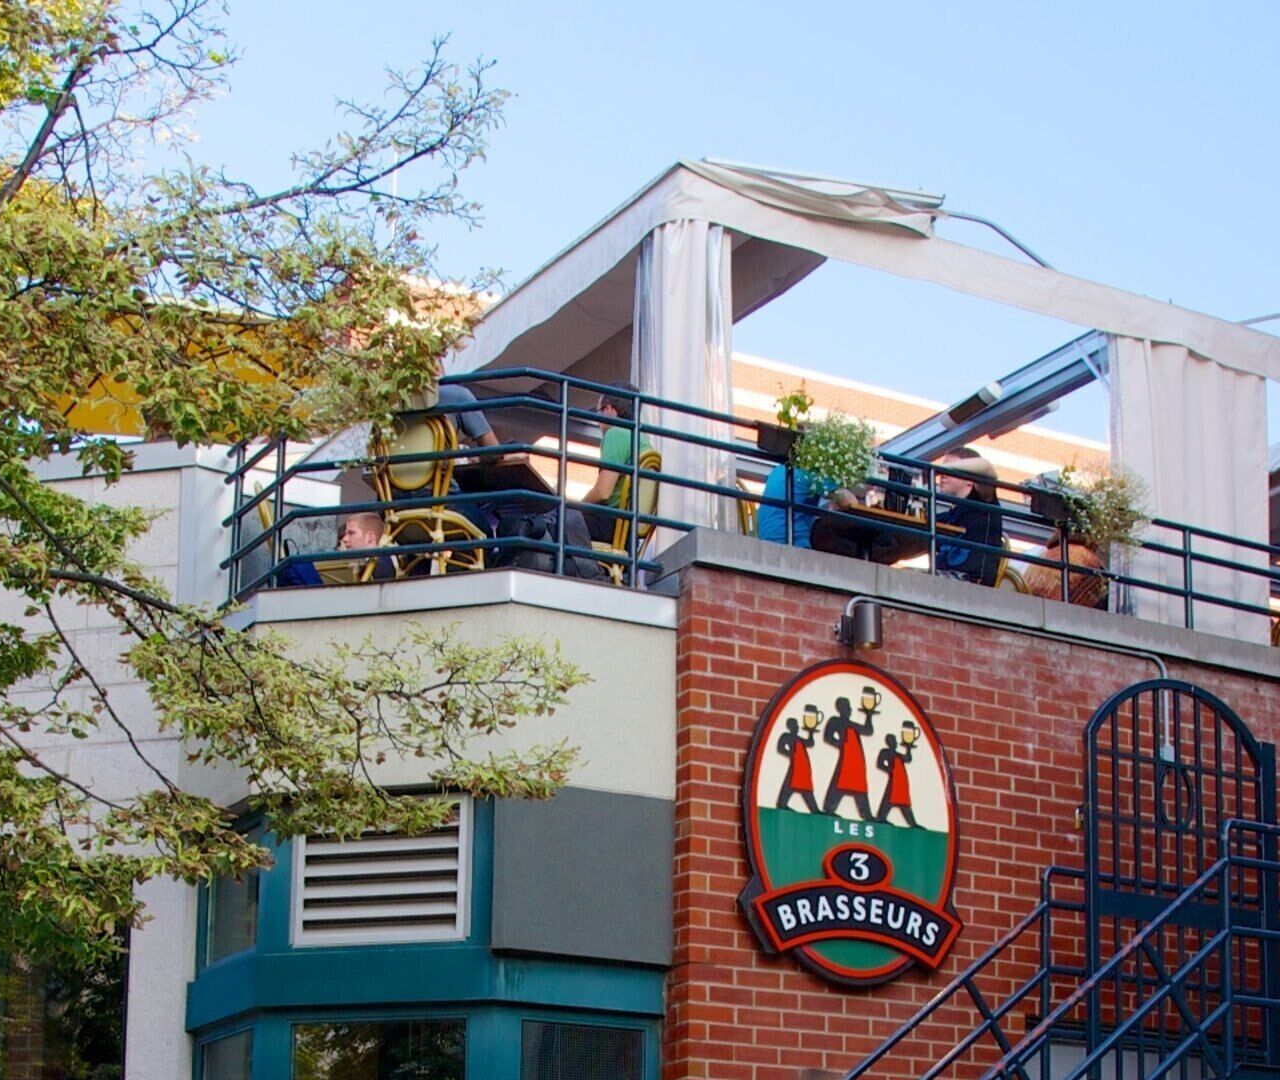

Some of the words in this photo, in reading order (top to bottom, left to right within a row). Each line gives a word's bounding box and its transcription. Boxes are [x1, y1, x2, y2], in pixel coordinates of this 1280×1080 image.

[833, 820, 875, 838] LES
[849, 851, 870, 881] 3
[776, 894, 940, 947] BRASSEURS
